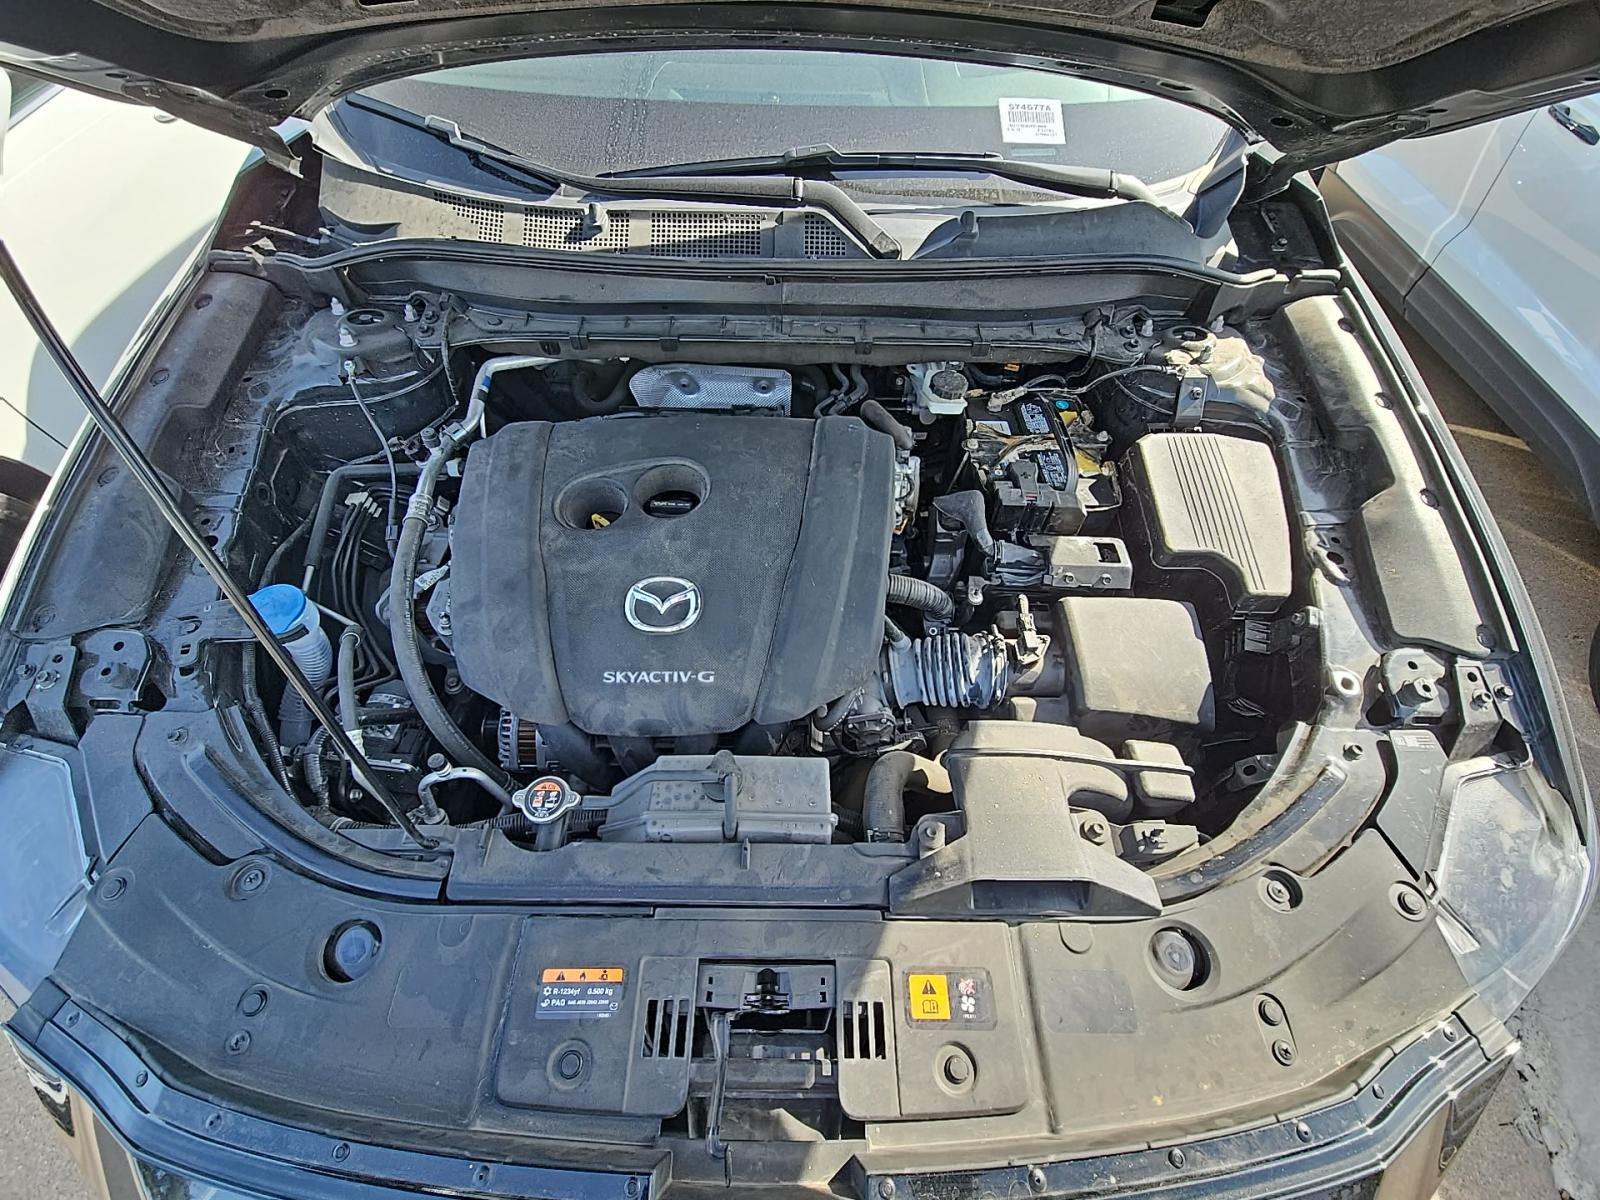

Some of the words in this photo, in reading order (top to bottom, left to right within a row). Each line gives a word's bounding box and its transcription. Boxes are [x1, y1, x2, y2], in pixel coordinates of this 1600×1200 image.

[602, 670, 716, 684] SKYACTIV-G
[552, 987, 581, 996] R-1234yf
[605, 987, 614, 996] kg
